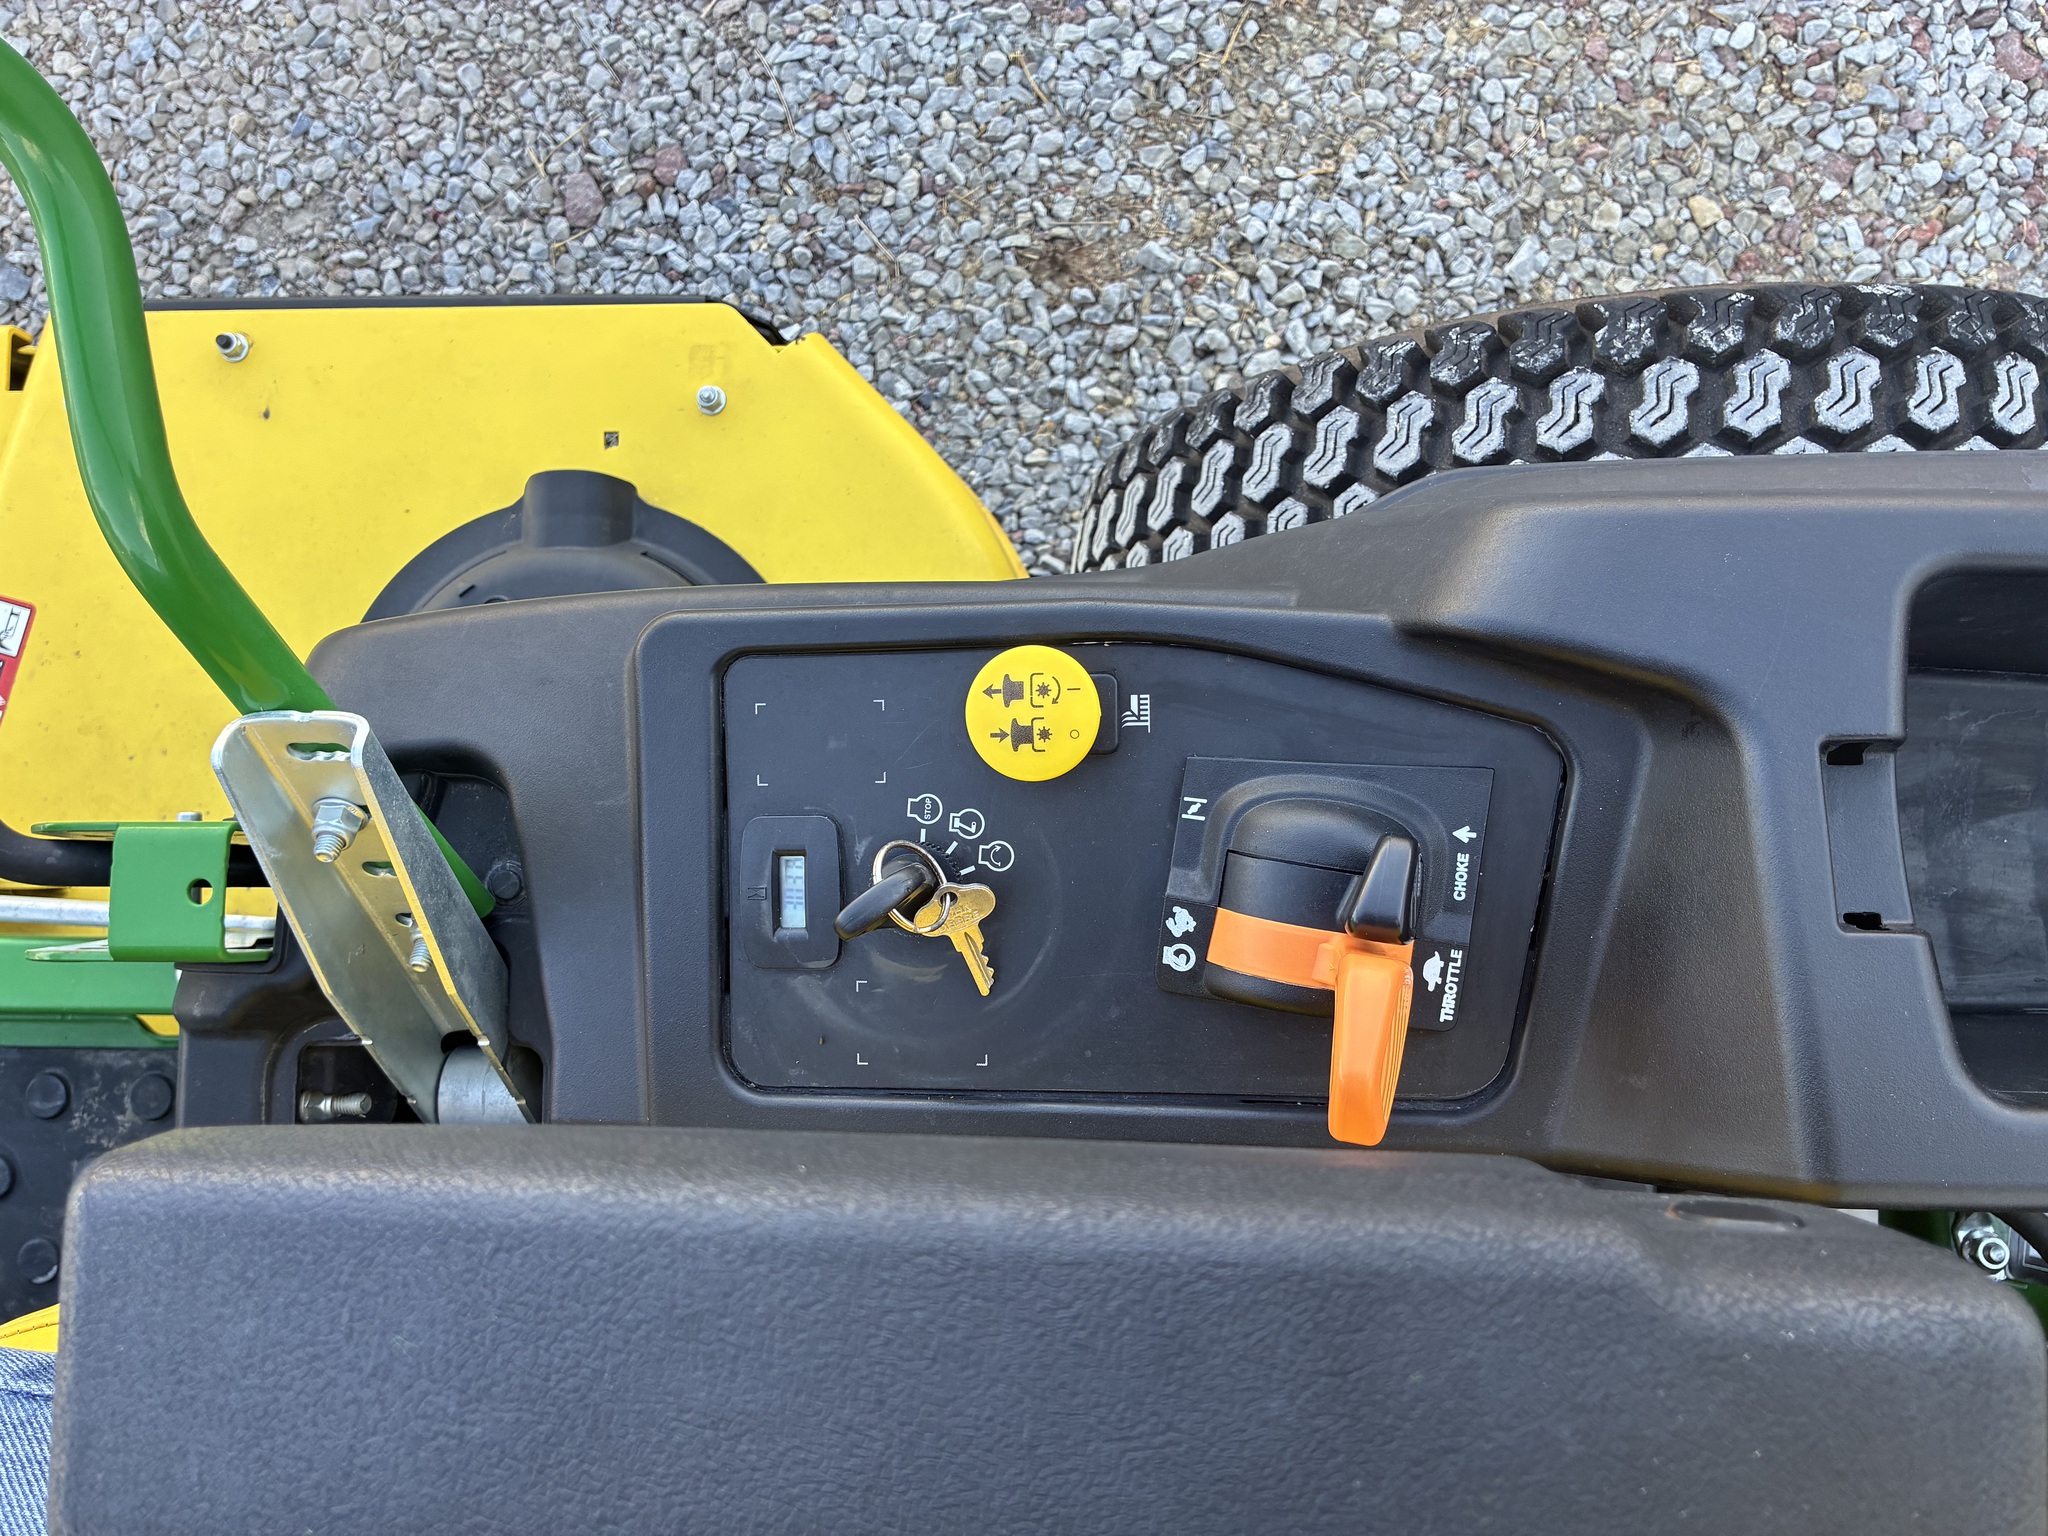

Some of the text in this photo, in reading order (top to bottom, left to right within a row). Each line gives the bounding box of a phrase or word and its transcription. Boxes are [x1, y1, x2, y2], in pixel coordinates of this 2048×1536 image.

[924, 798, 932, 819] STOP
[1454, 853, 1469, 901] CHOKE
[1440, 949, 1463, 1022] THROTTLE
